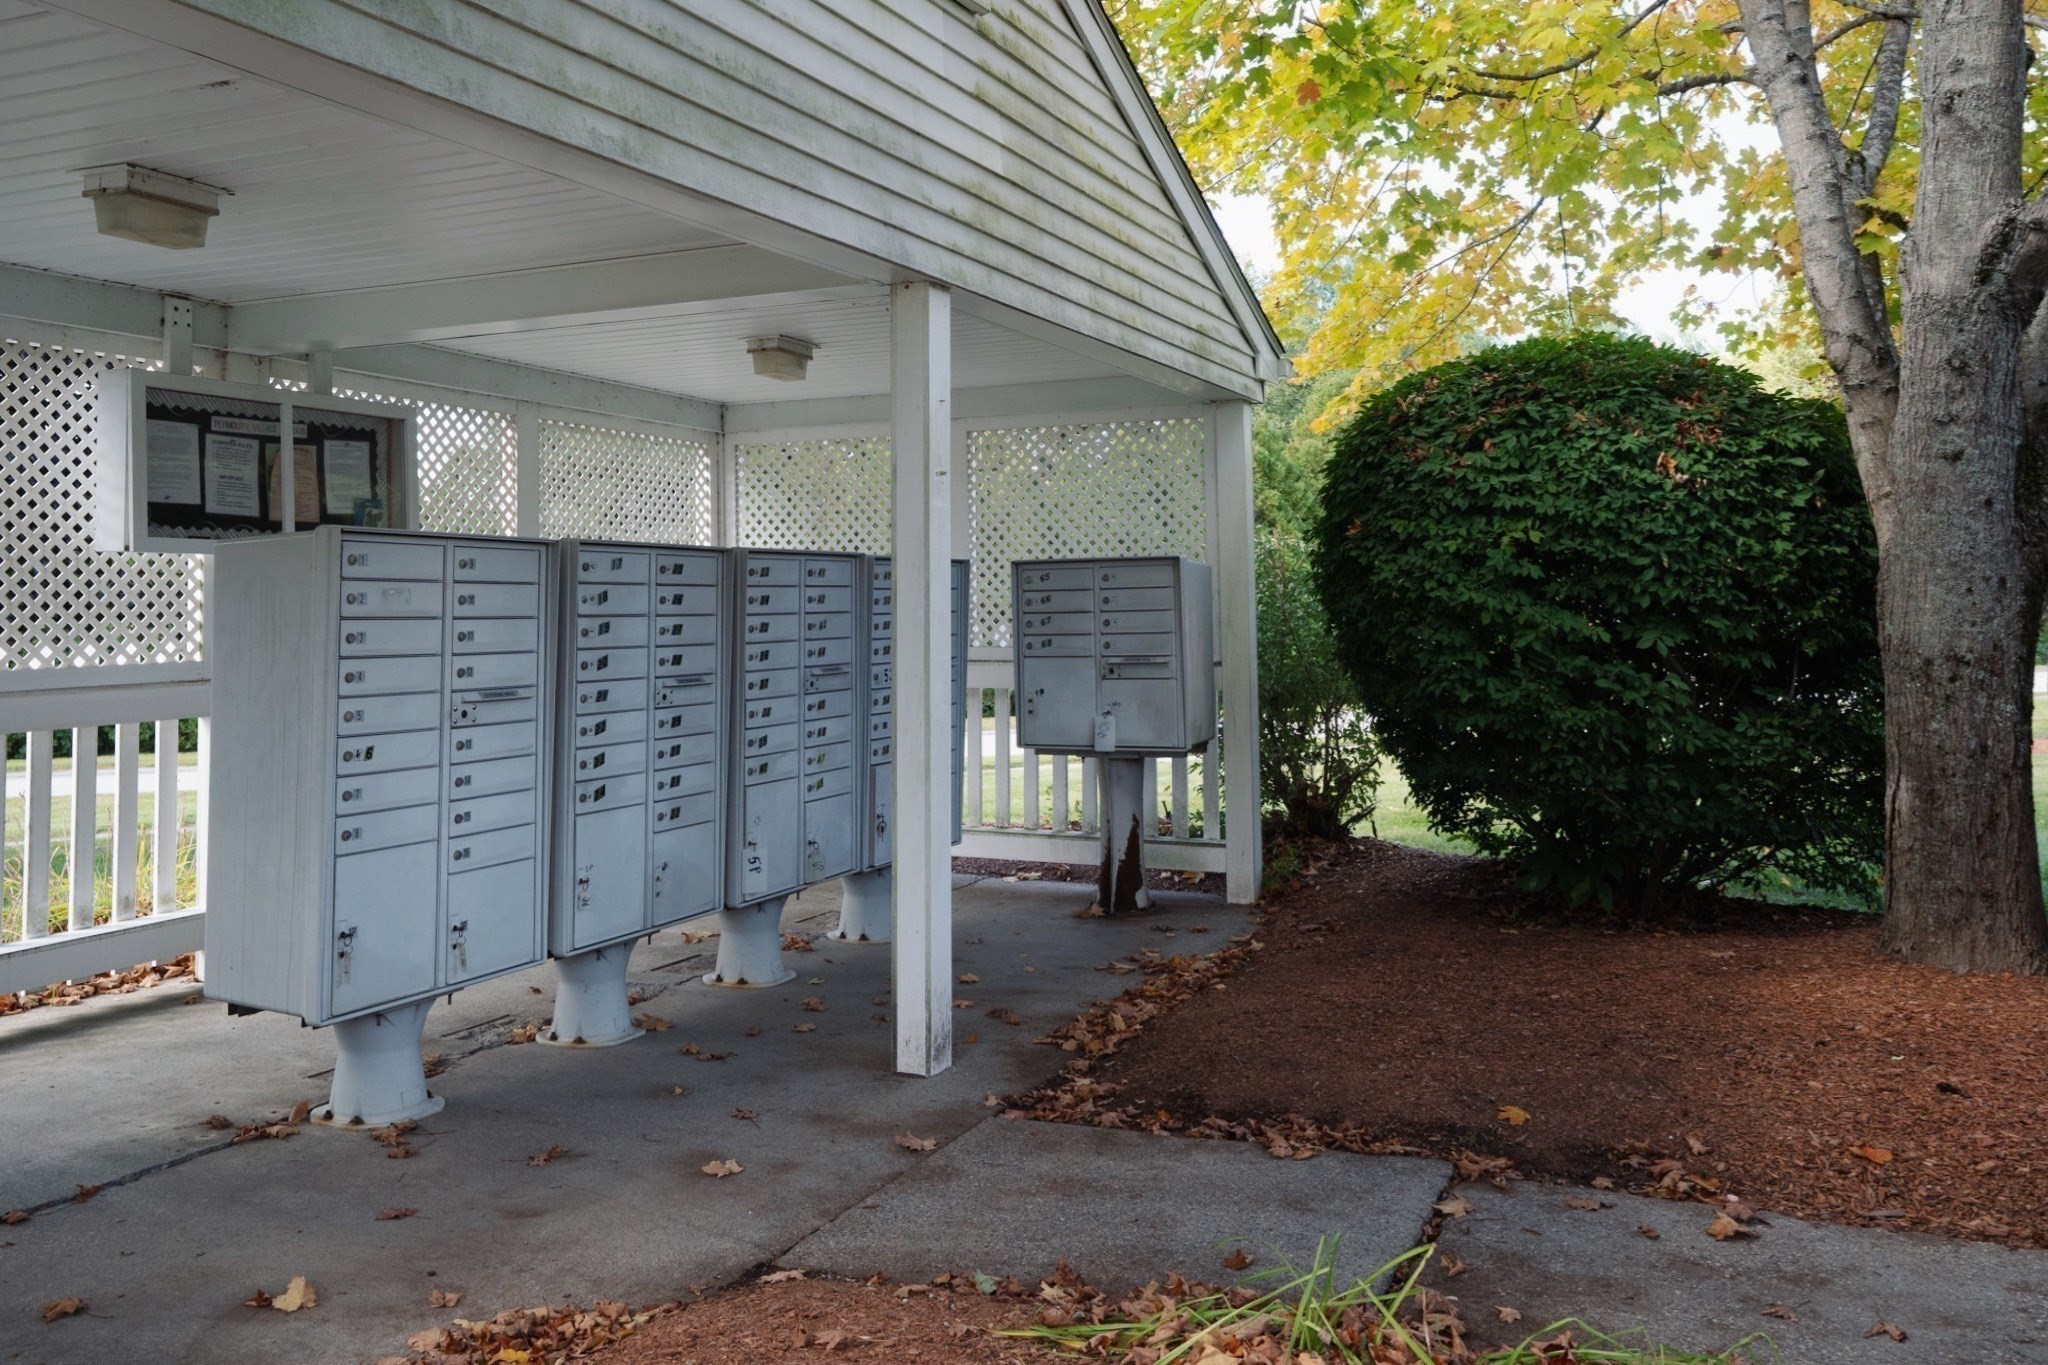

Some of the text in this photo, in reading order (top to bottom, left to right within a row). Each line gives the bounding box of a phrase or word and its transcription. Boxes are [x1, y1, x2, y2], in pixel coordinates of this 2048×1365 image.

[214, 419, 251, 431] PLYMOUTH
[252, 423, 278, 433] VILLAGE
[611, 556, 622, 571] 17
[672, 563, 684, 575] 25
[760, 567, 770, 577] 33
[818, 568, 826, 578] 41
[883, 571, 892, 580] 49
[1040, 573, 1050, 583] 65
[467, 595, 475, 605] 10
[598, 589, 608, 606] 18
[672, 593, 684, 605] 26
[817, 594, 826, 604] 42
[883, 596, 891, 605] 50
[1041, 595, 1052, 604] 66
[819, 620, 827, 631] 43
[1041, 616, 1052, 626] 67
[598, 620, 610, 636] 19
[672, 623, 684, 635] 27
[759, 622, 770, 633] 35
[467, 631, 474, 641] 11
[1042, 638, 1053, 648] 68
[817, 647, 826, 657] 44
[597, 654, 608, 671] 20
[671, 654, 683, 666] 28
[466, 667, 474, 677] 12
[596, 689, 609, 703] 21
[465, 739, 472, 749] 13
[817, 753, 825, 764] 47
[464, 776, 471, 785] 14
[816, 778, 824, 790] 48
[463, 812, 471, 822] 15
[463, 848, 470, 858] 16
[747, 856, 762, 874] 5P
